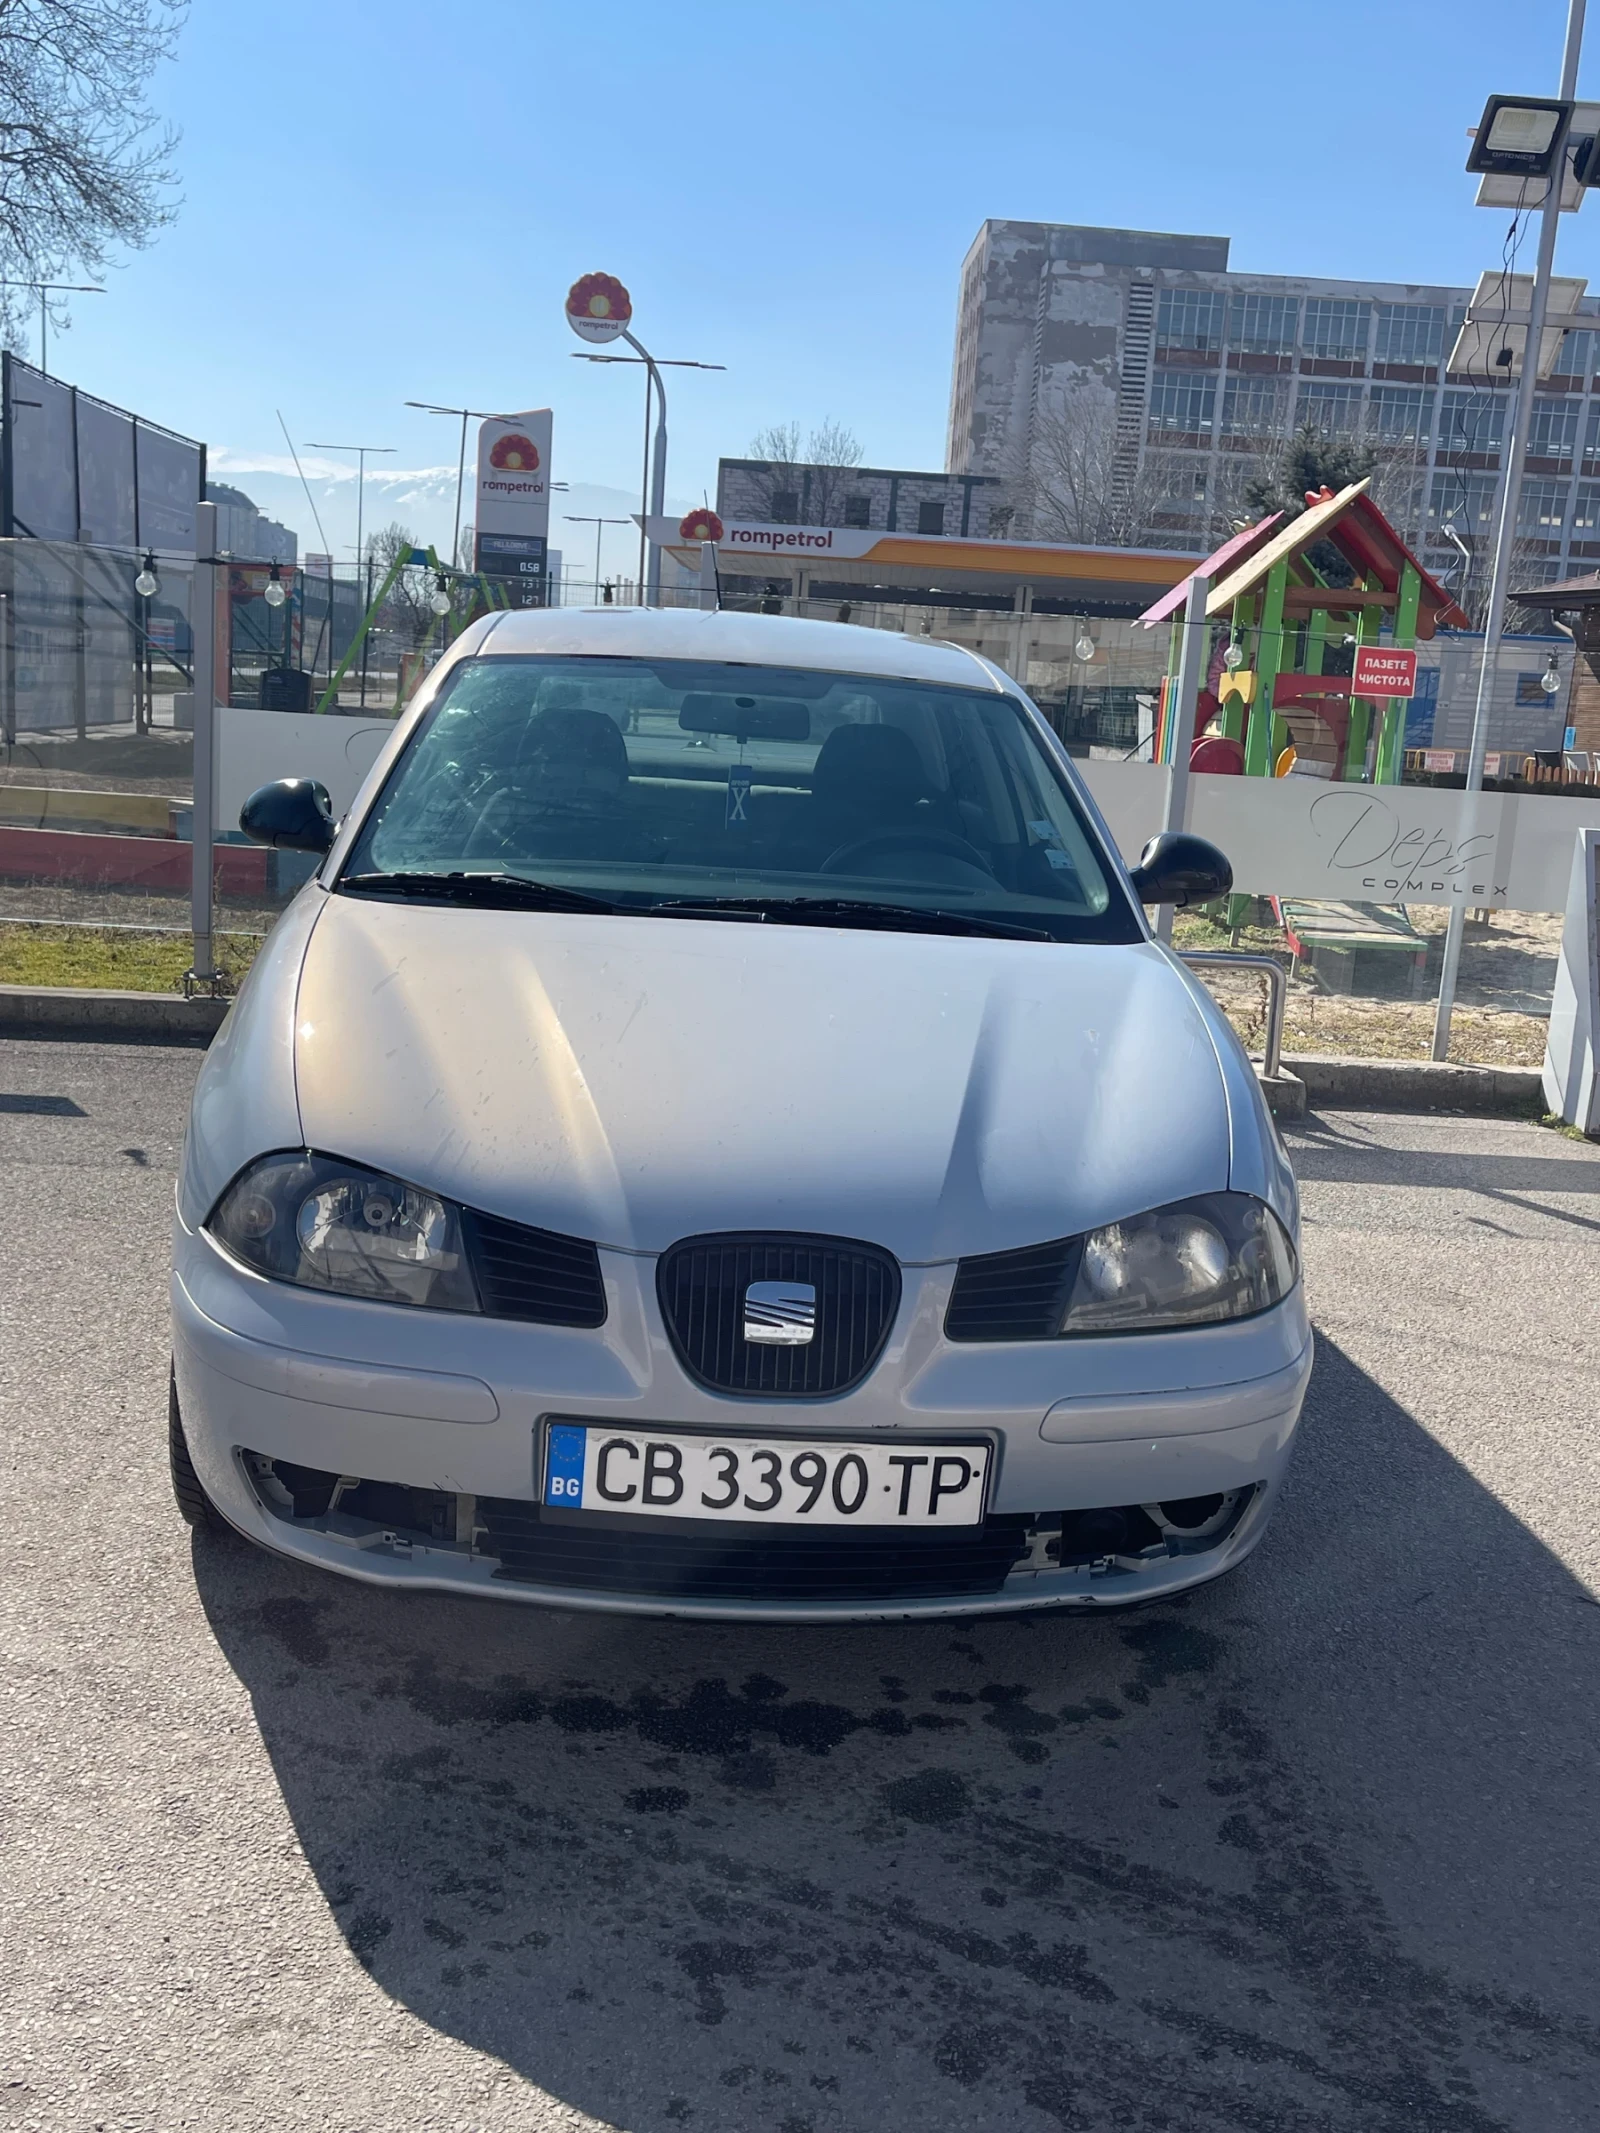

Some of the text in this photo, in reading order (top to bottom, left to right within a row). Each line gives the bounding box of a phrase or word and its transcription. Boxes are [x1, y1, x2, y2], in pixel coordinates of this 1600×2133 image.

[578, 321, 619, 330] rompetrol
[482, 481, 544, 494] rompetrol
[731, 529, 833, 551] rompetrol
[1364, 657, 1408, 670] ПАЗЕТЕ
[1358, 673, 1411, 687] ЧИСТОТА
[1362, 878, 1508, 896] COMPLEX
[597, 1437, 972, 1516] CB 3390 TP
[551, 1476, 580, 1497] BG
